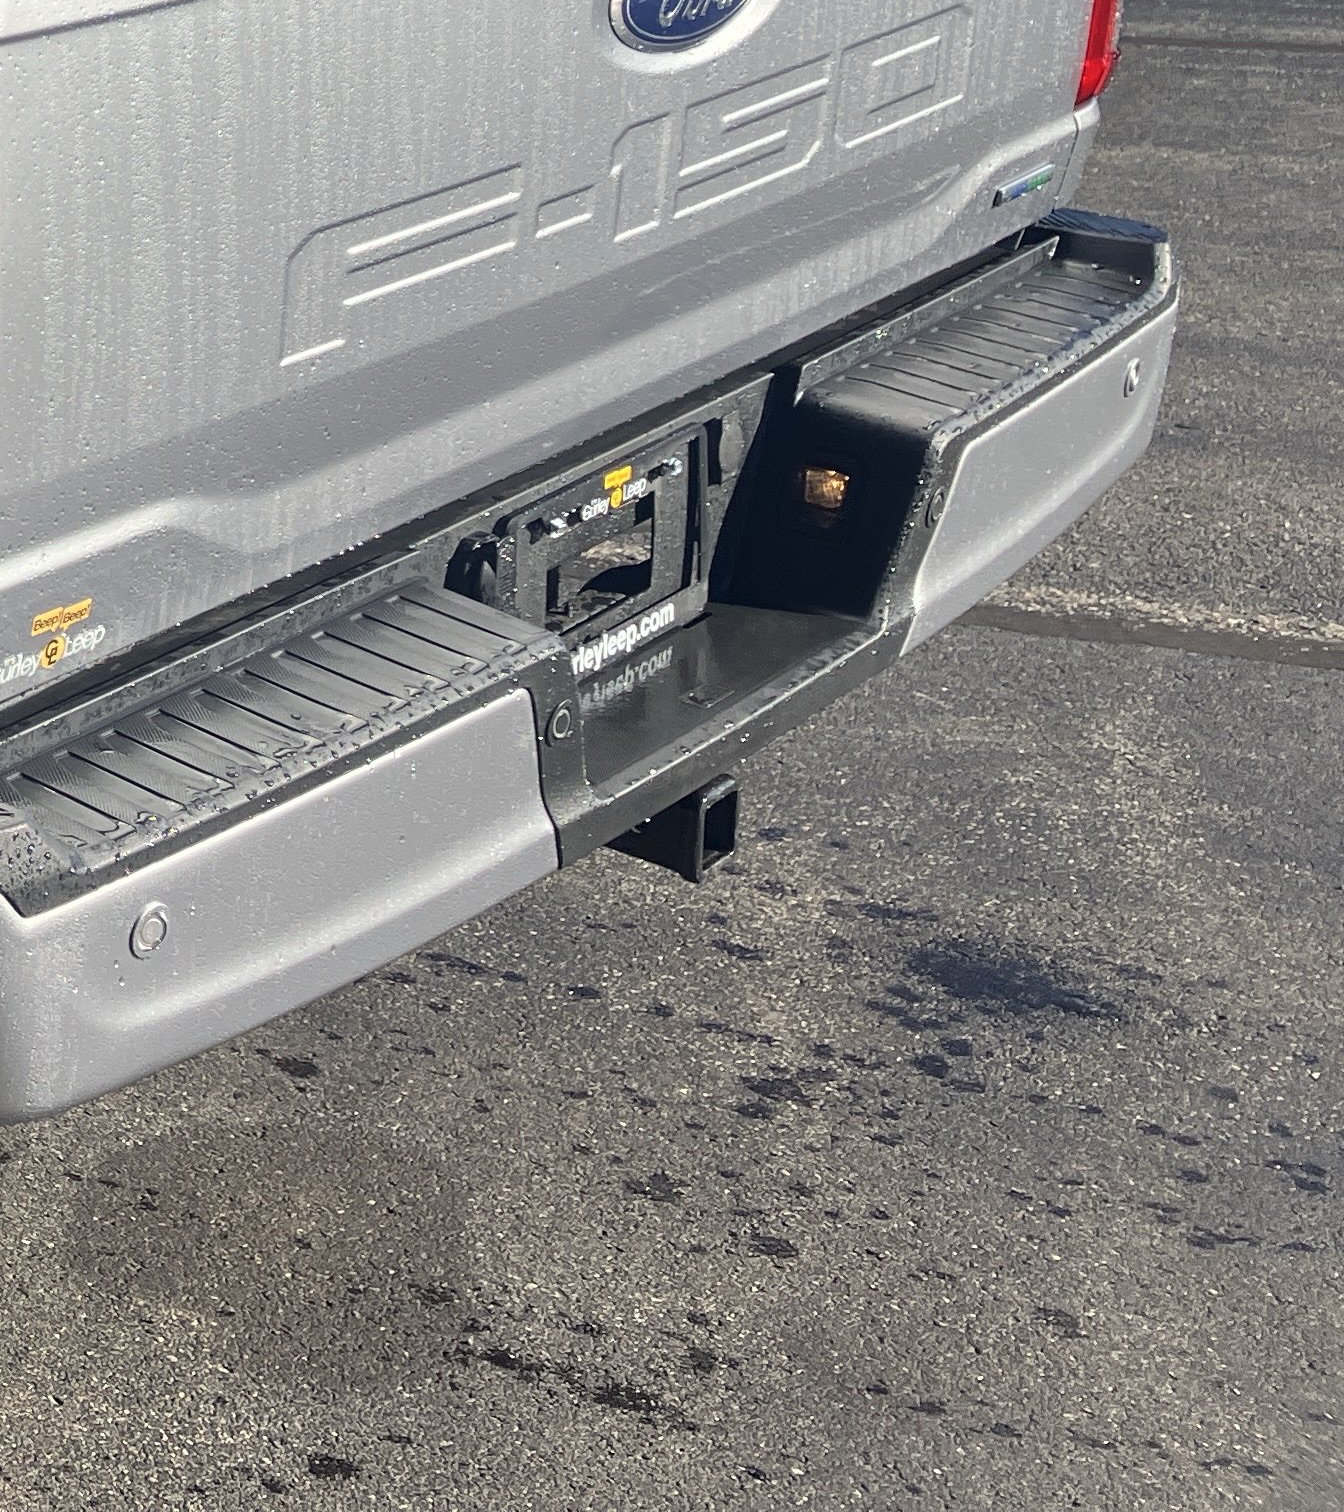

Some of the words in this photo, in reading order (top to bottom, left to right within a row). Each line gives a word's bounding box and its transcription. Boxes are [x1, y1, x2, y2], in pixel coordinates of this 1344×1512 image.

[279, 3, 972, 367] F-150
[63, 624, 106, 657] Leep
[570, 602, 675, 676] rleyleep.com
